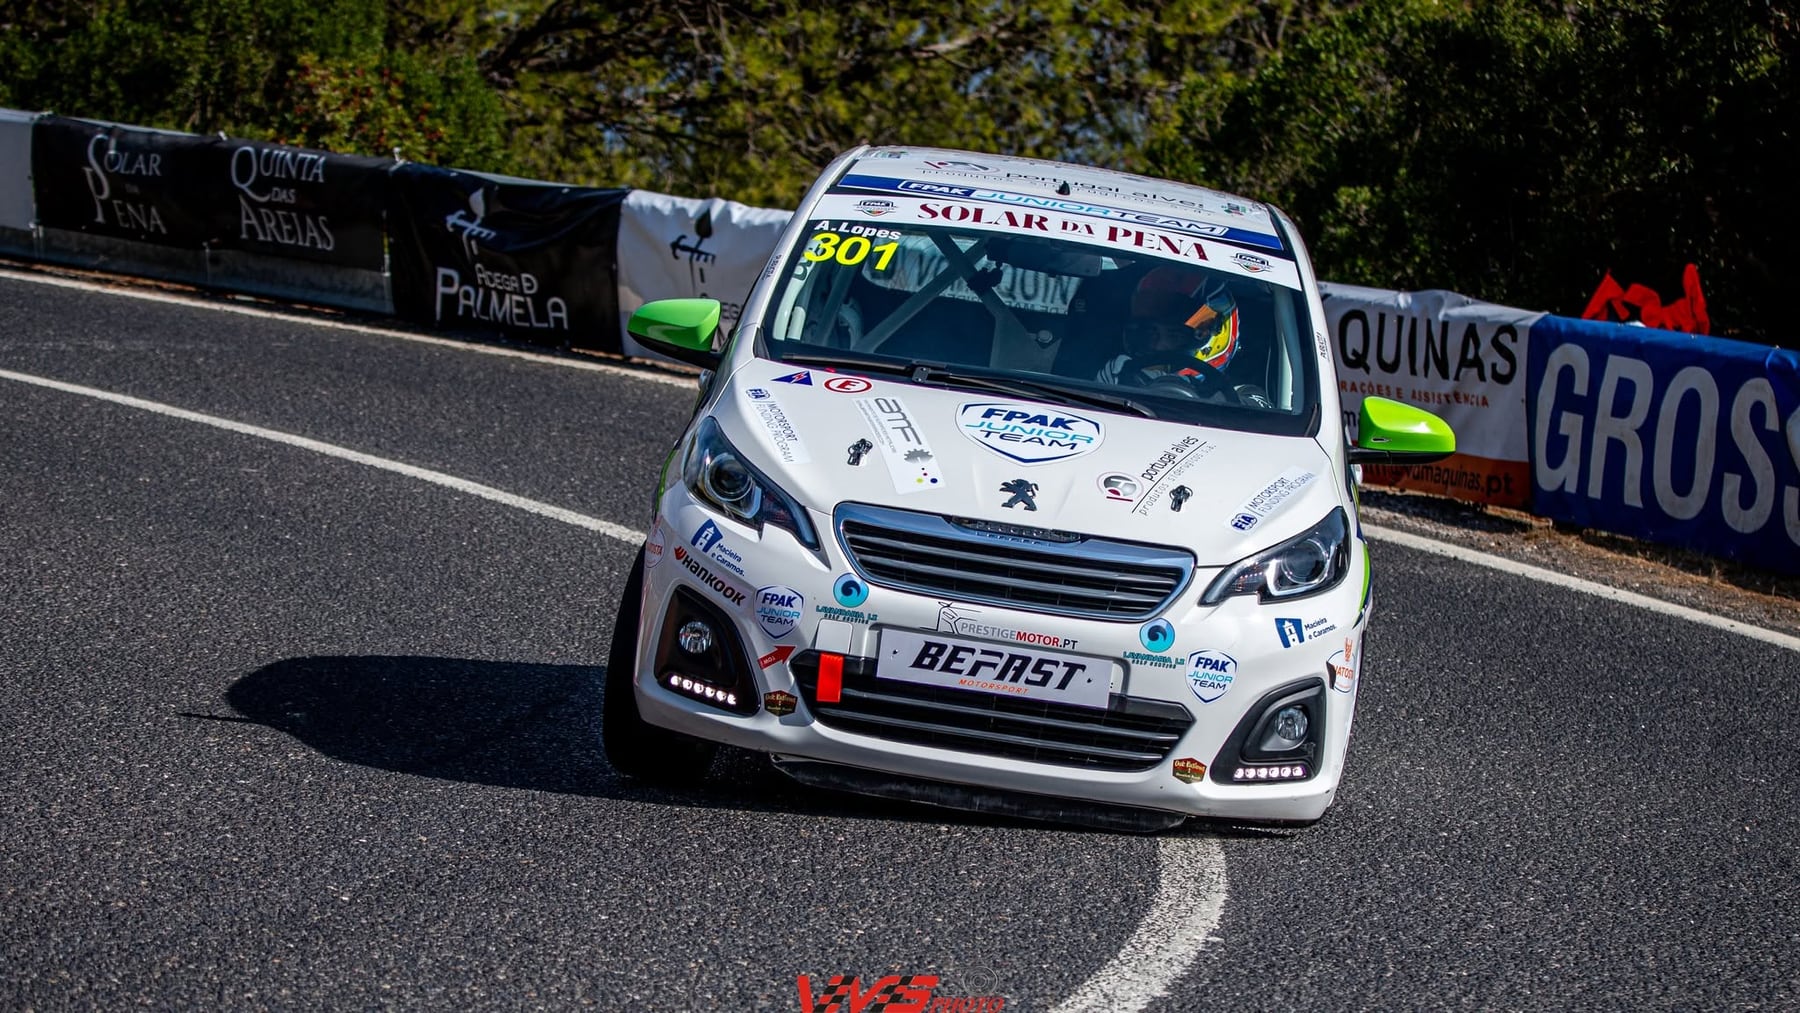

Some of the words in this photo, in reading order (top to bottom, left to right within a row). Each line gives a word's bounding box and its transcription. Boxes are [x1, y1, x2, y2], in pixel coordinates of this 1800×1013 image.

[230, 146, 326, 202] QUINTA
[271, 187, 296, 203] DAS
[909, 182, 968, 196] FPAK
[238, 195, 335, 252] AREIAS
[814, 220, 902, 240] A.Lopes
[917, 203, 1049, 232] SOLAR
[1061, 219, 1095, 235] DA
[1107, 225, 1209, 262] PENA
[803, 232, 900, 272] 301
[435, 266, 569, 331] PALMELA
[1337, 308, 1519, 386] QUINAS
[837, 379, 859, 391] E
[1340, 379, 1393, 397] RAÇÕES
[1395, 386, 1404, 400] E
[980, 407, 1081, 431] FPAK
[965, 421, 1095, 444] JUNIOR
[979, 430, 1079, 450] TEAM
[1141, 450, 1178, 482] portugal
[1170, 435, 1199, 454] alves
[1138, 482, 1170, 516] produtos
[1232, 514, 1255, 531] FIA
[1249, 476, 1291, 510] MOTORSPORT
[715, 543, 742, 562] Macieira
[716, 553, 745, 577] Caramos.
[761, 592, 798, 608] FPAK
[756, 607, 801, 619] JUNIOR
[760, 614, 794, 627] TEAM
[1304, 617, 1328, 632] Macieira
[959, 622, 1080, 651] PRESTIGEMOTOR.PT
[909, 640, 1088, 691] BEFAST
[1194, 656, 1231, 673] FPAK
[957, 677, 1030, 695] MOTORSPORT
[1187, 670, 1234, 684] JUNIOR
[1192, 678, 1227, 691] TEAM
